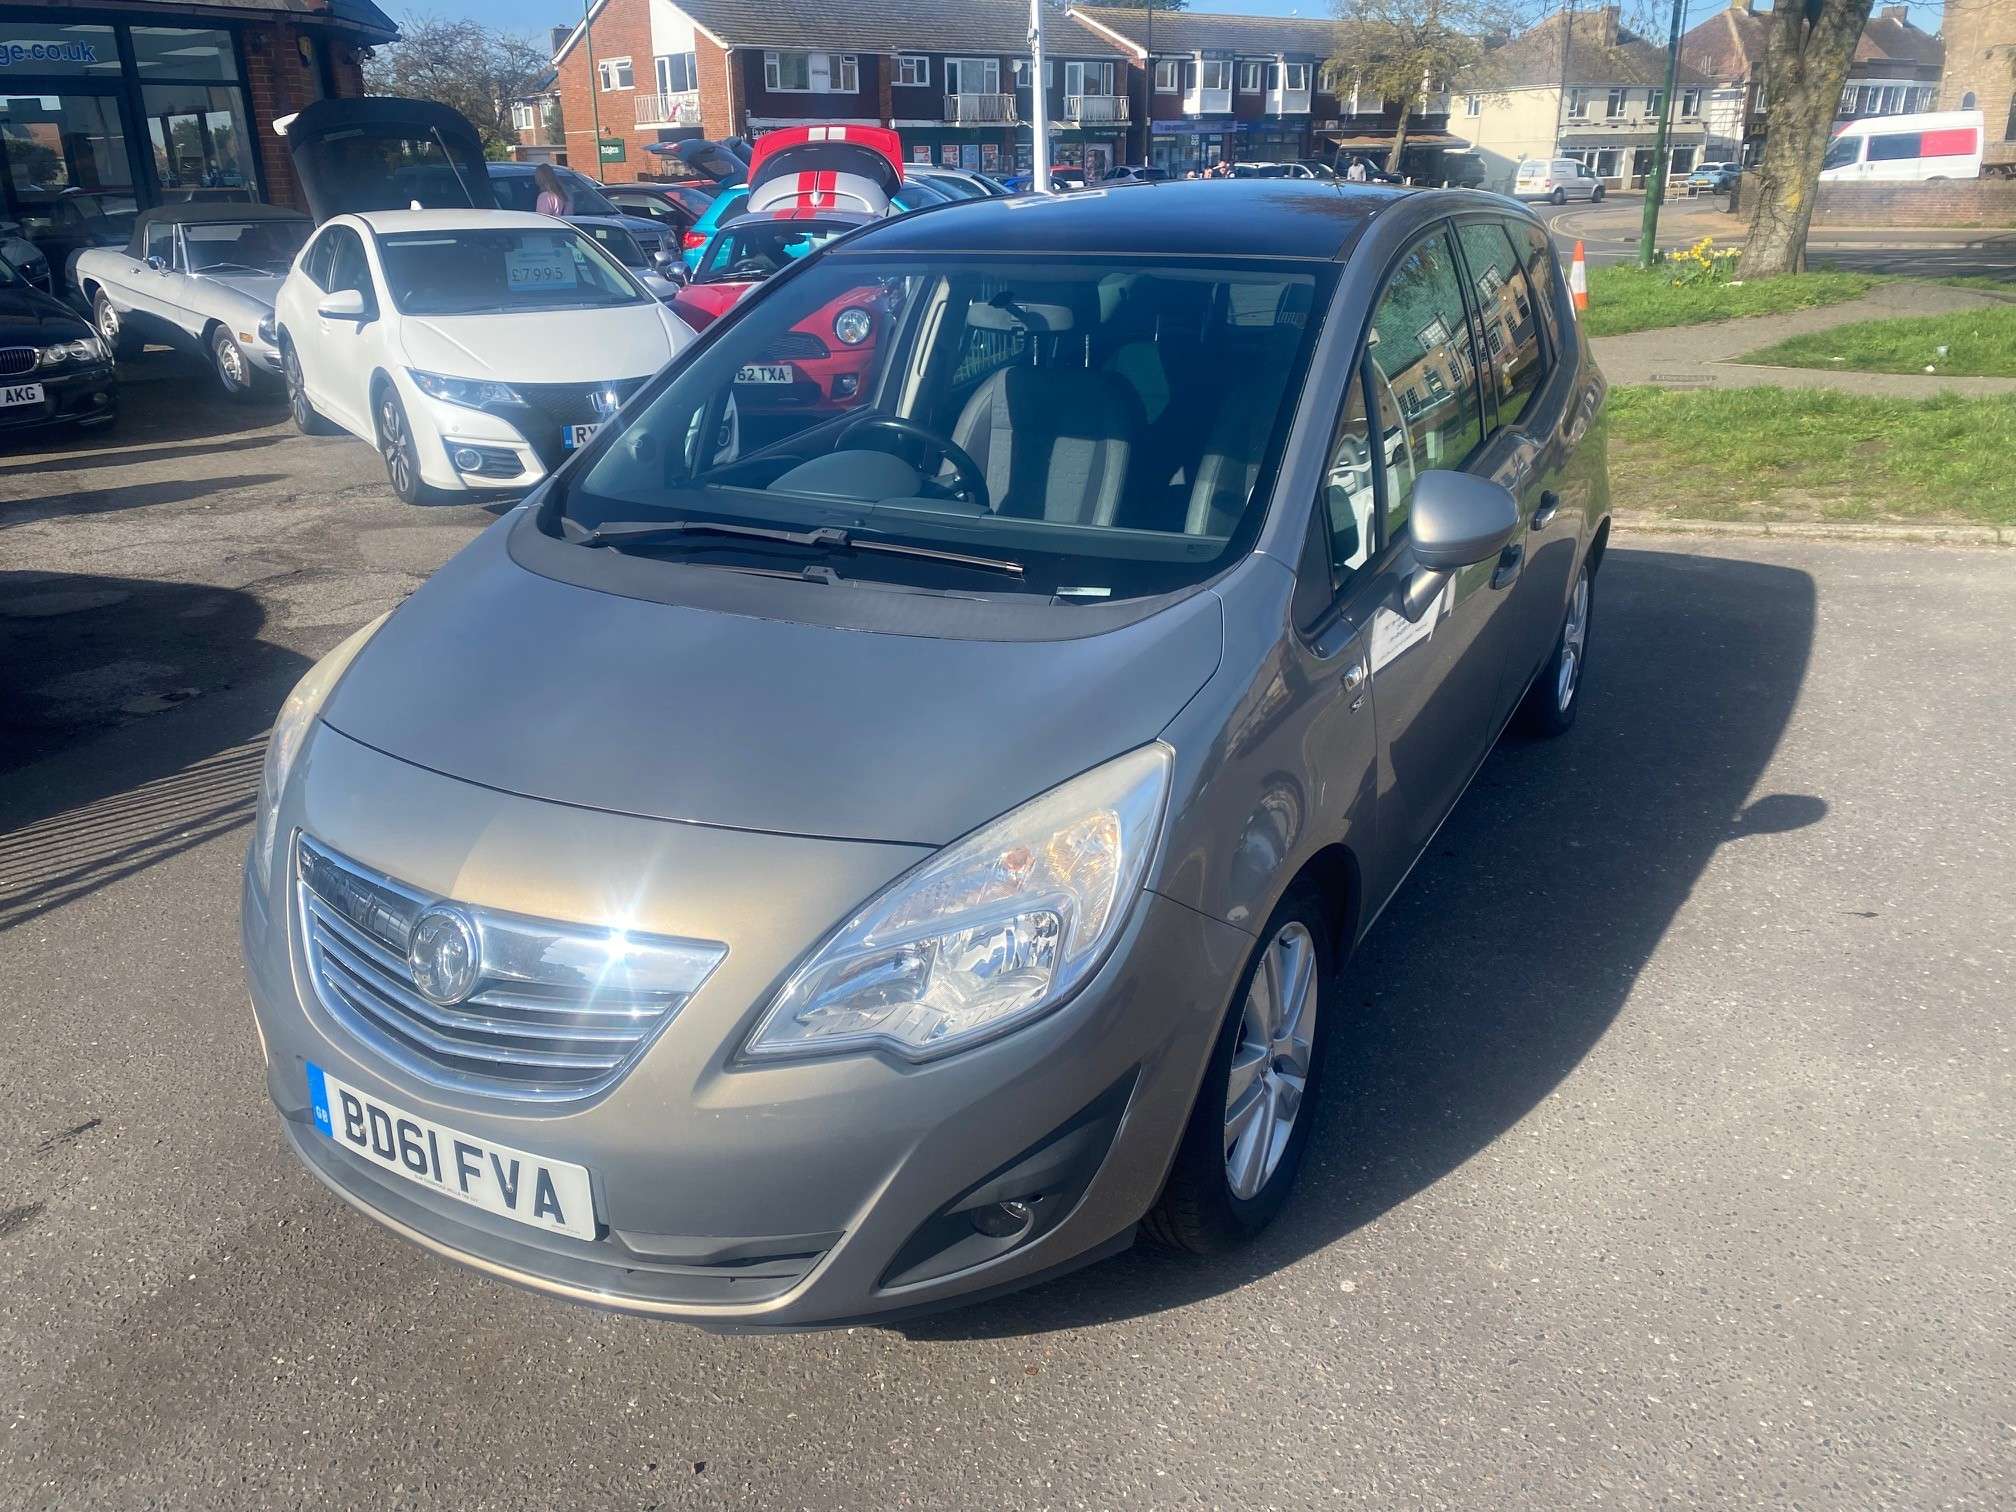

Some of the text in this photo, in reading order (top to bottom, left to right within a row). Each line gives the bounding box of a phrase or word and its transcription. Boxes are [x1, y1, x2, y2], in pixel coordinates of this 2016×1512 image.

[759, 367, 786, 381] TXA
[5, 386, 36, 403] AKG
[315, 1104, 329, 1123] GB
[338, 1087, 566, 1225] BD61 FVA
